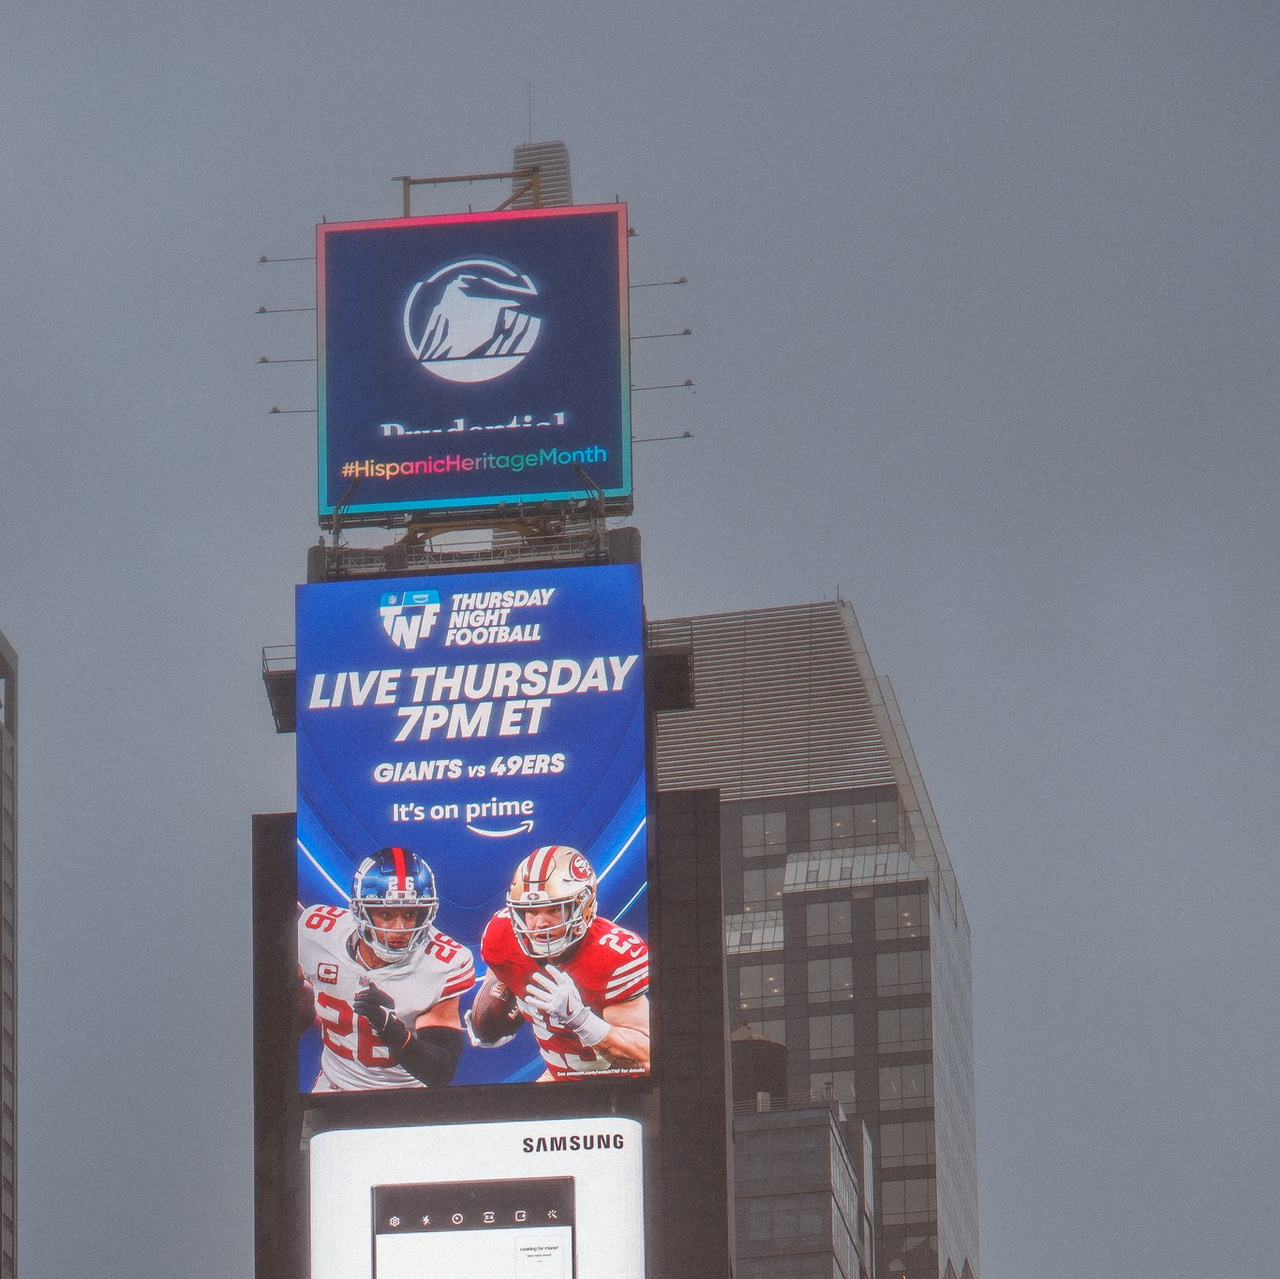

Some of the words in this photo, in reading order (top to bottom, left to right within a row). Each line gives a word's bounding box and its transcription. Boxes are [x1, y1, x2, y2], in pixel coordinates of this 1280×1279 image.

[342, 445, 607, 480] #HispanicHeritageMonth
[452, 588, 555, 611] THURSDAY
[380, 604, 440, 650] TNF
[449, 609, 510, 628] NIGHT
[445, 624, 540, 646] FOOTBALL
[309, 669, 401, 709] LIVE
[410, 655, 638, 702] THURSDAY
[395, 702, 491, 741] 7PM
[499, 699, 551, 735] ET
[374, 760, 462, 783] GIANTS
[490, 753, 565, 777] 49ERS
[393, 803, 425, 822] It's
[431, 803, 459, 819] on
[466, 797, 533, 822] prime
[522, 1135, 624, 1153] SAMSUNG
